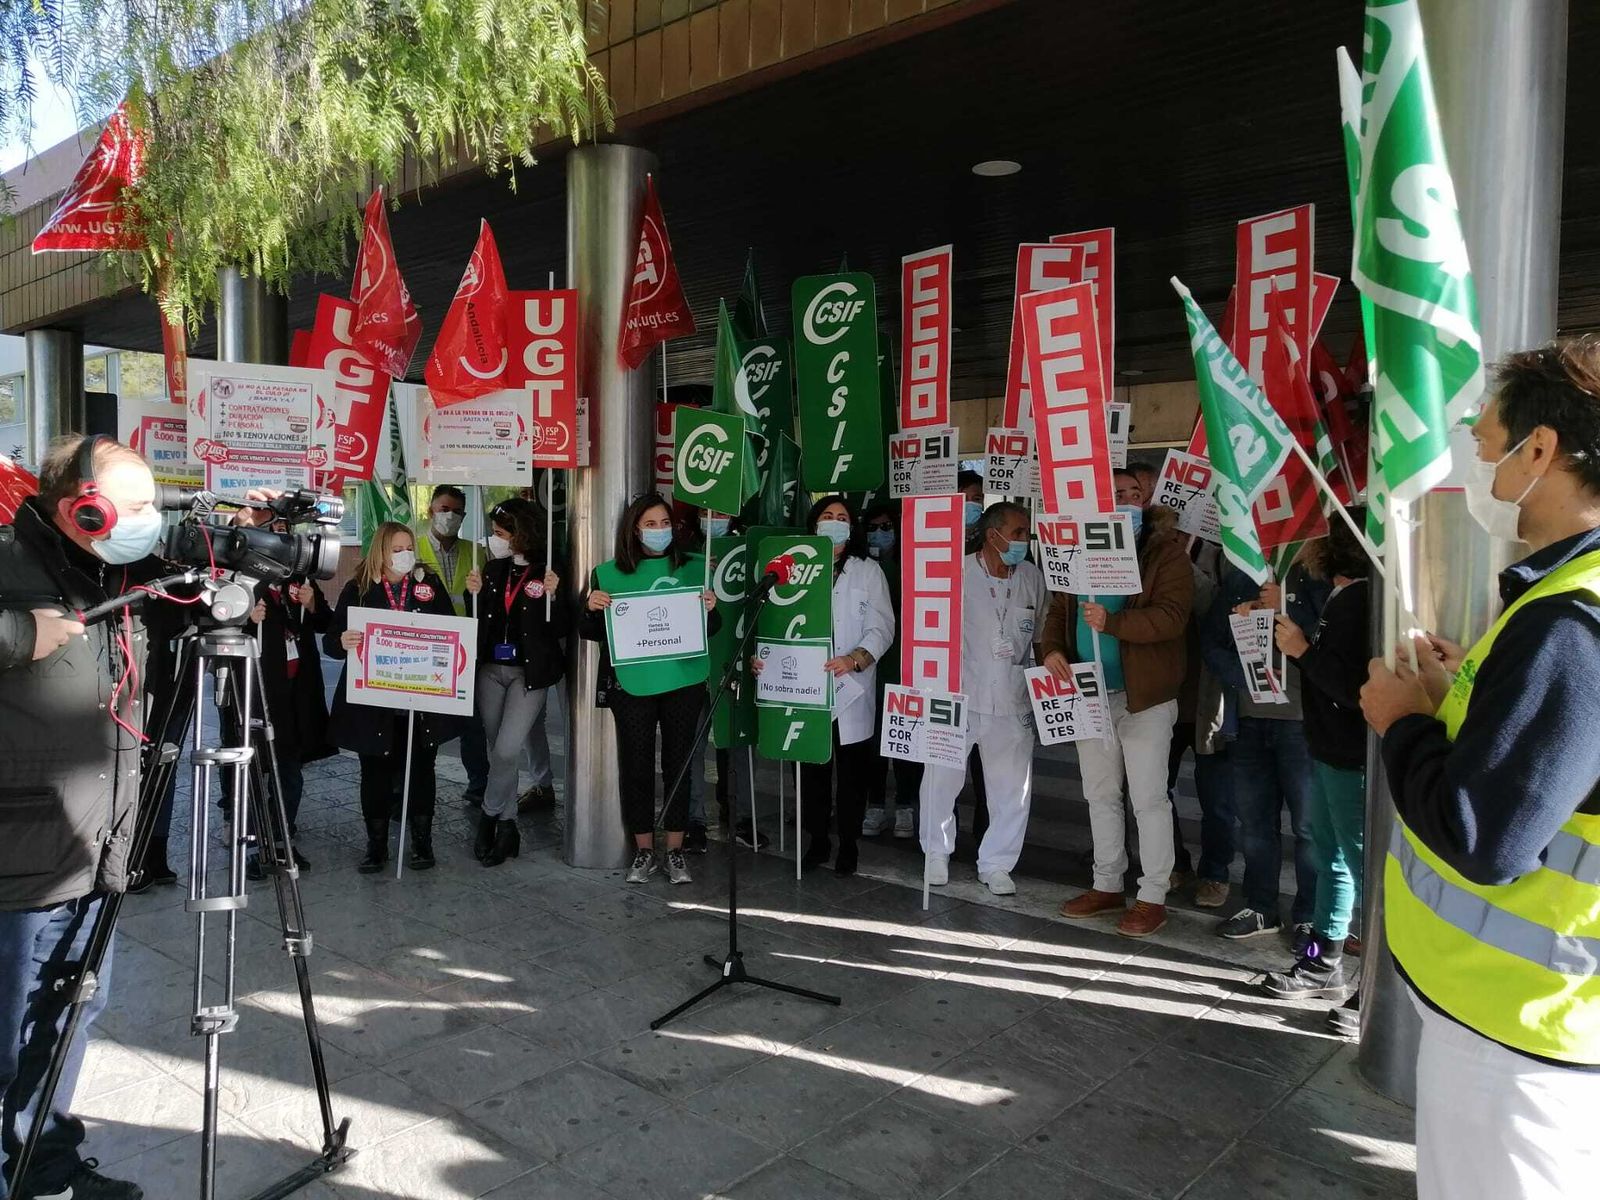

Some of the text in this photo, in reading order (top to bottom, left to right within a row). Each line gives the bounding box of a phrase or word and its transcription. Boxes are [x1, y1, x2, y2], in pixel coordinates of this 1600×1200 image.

[815, 300, 866, 324] CSIF
[910, 263, 940, 421] CCOO
[522, 298, 565, 418] UGT
[1035, 298, 1099, 513] CCOO
[826, 351, 854, 484] CSIF
[154, 431, 174, 442] 8.000
[243, 431, 300, 442] RENOVACIONES
[545, 426, 559, 436] FSP
[338, 434, 356, 445] FSP
[988, 434, 1029, 457] NO
[891, 435, 950, 460] NO SI
[154, 449, 180, 460] NUEVO
[687, 444, 734, 475] CSIF
[990, 456, 1005, 466] RE
[893, 460, 904, 470] RE
[893, 471, 912, 482] COR
[989, 468, 1014, 479] COR
[1164, 457, 1212, 490] NO
[220, 478, 247, 489] NUEVO
[893, 484, 911, 494] TES
[988, 480, 1010, 491] TES
[1164, 481, 1182, 495] RE
[1160, 494, 1187, 511] COR
[1037, 521, 1125, 550] NO SI
[1045, 546, 1059, 558] RE
[253, 562, 270, 573] JVC
[1048, 560, 1070, 573] COR
[1049, 574, 1070, 587] TES
[912, 496, 953, 691] CCOO
[636, 635, 682, 648] +Personal
[376, 655, 398, 665] NUEVO
[760, 682, 821, 695] ¡No sobra nadie!
[887, 691, 961, 727] NO SI
[1041, 698, 1061, 711] RE
[889, 715, 905, 727] RE
[1045, 711, 1074, 725] COR
[888, 728, 912, 742] COR
[1047, 725, 1075, 738] TES
[887, 741, 910, 755] TES
